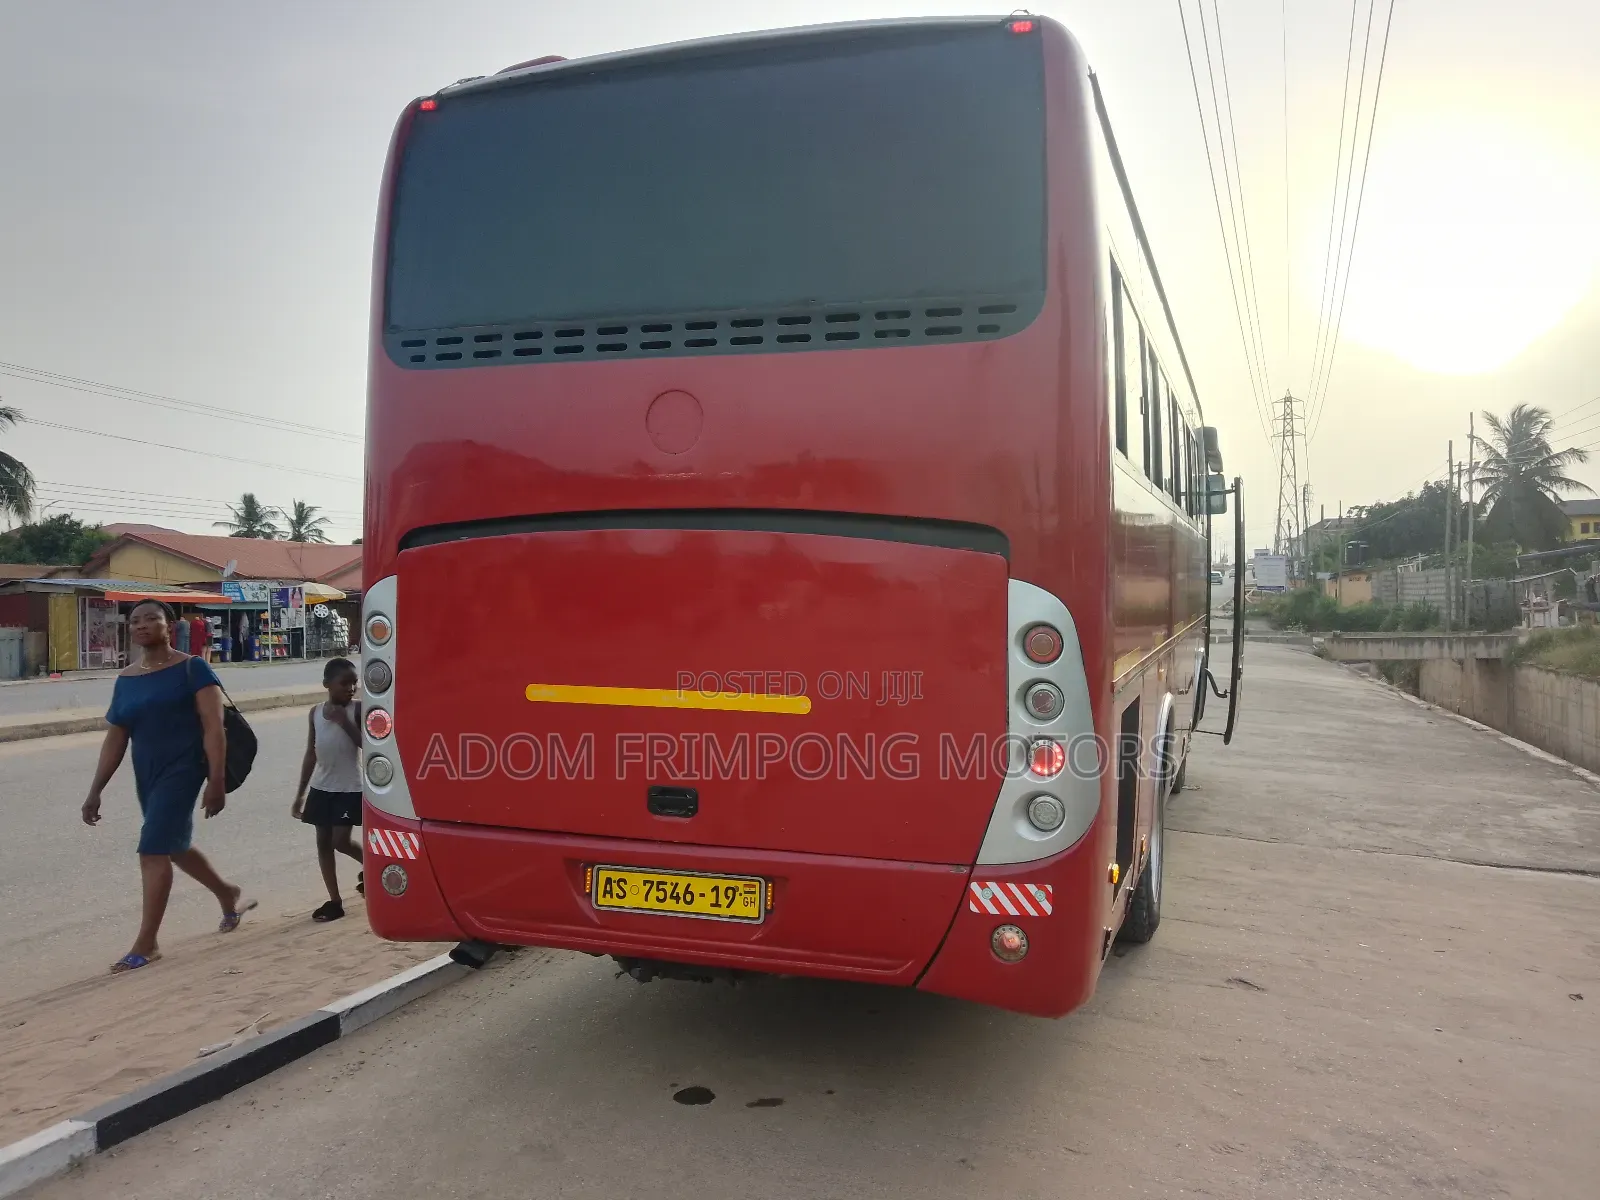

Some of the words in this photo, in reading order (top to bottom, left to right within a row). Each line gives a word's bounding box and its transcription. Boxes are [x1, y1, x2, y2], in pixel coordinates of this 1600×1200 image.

[602, 876, 628, 900] AS
[642, 879, 737, 909] 7546-19
[742, 896, 756, 909] GH
